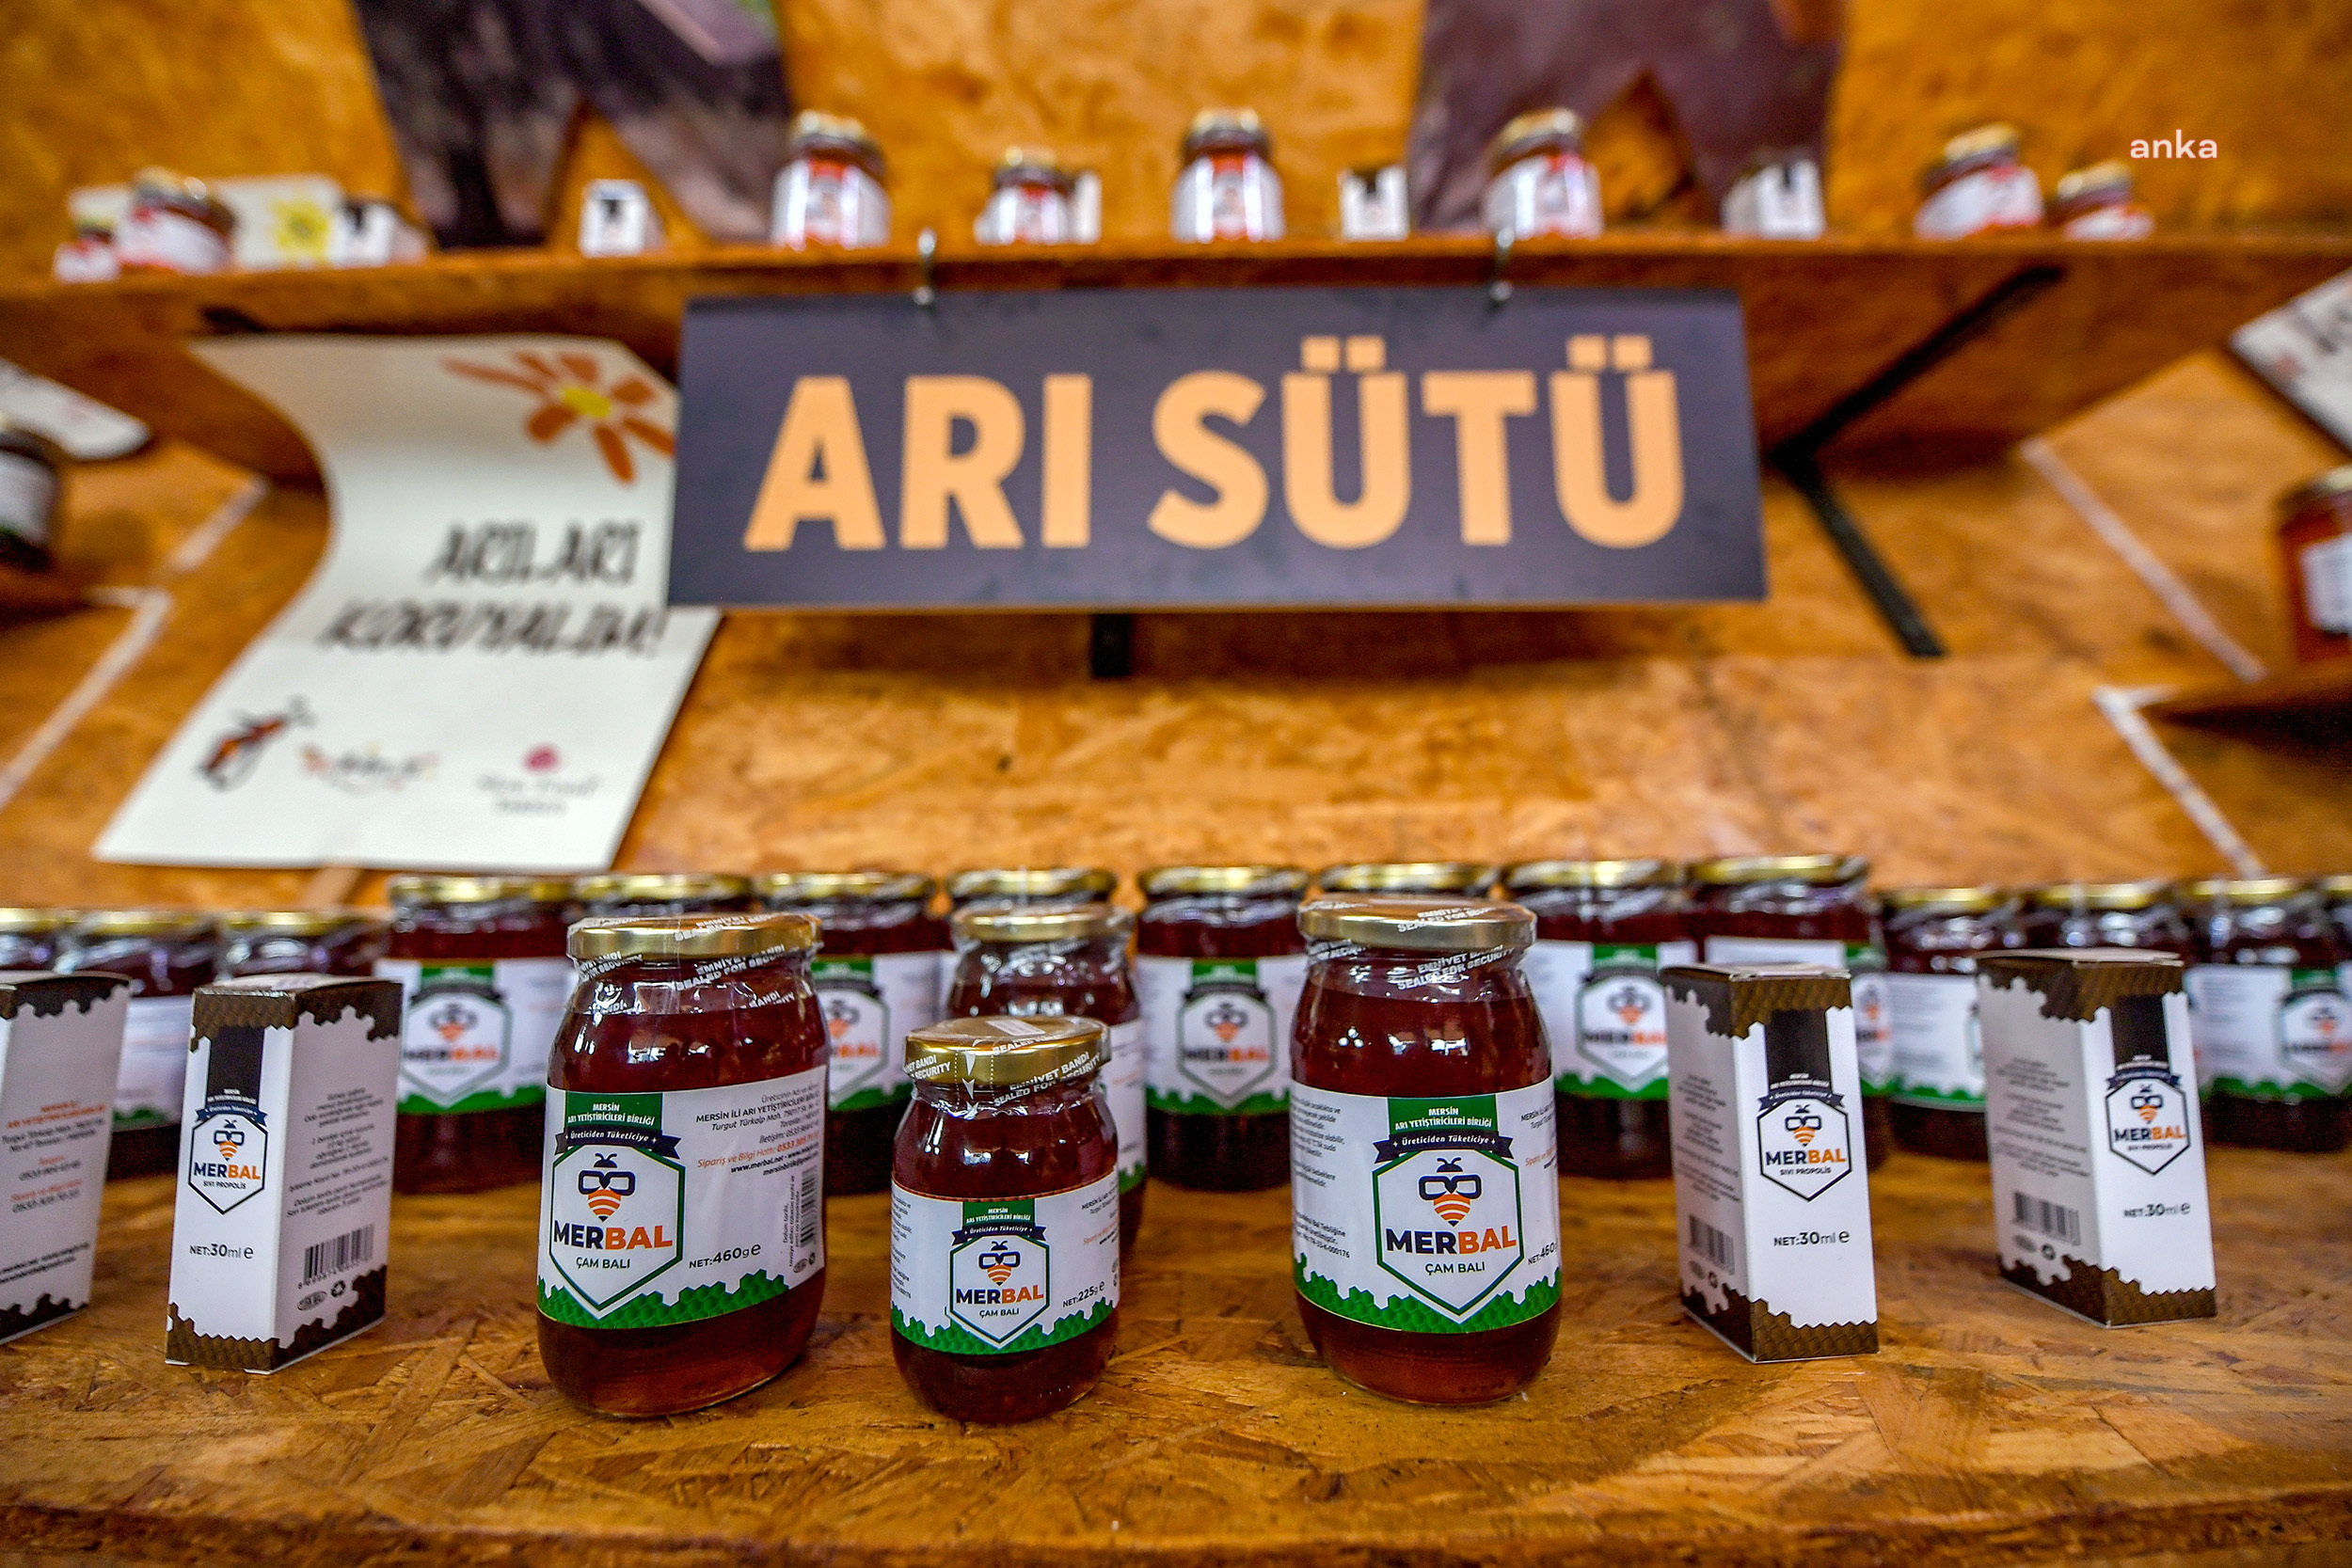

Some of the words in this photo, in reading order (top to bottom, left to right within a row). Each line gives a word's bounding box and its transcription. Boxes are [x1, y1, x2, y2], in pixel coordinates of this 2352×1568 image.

[743, 373, 1092, 551] ARI
[1147, 335, 1686, 551] SÜTÜ
[1061, 1051, 1089, 1074] BANDI
[593, 1102, 620, 1112] MERSİN
[1428, 1106, 1458, 1116] MERSİN
[567, 1116, 577, 1124] ARI
[627, 1115, 655, 1126] BİRLİĞİ
[696, 1112, 729, 1122] MERSİN
[742, 1107, 755, 1117] ARI
[1395, 1121, 1407, 1130] ARI
[1409, 1116, 1465, 1128] YETİŞTİRİCİLERİ
[1467, 1117, 1492, 1128] BİRLİĞİ
[570, 1131, 604, 1139] Üreticiden
[607, 1131, 649, 1142] Tüketiciye
[1402, 1135, 1445, 1146] Üreticiden
[1448, 1135, 1488, 1144] Tüketiciye
[2114, 1125, 2185, 1142] MERBAL
[1766, 1148, 1846, 1165] MERBAL
[194, 1162, 261, 1180] MERBAL
[553, 1220, 673, 1250] MERBAL
[1386, 1226, 1517, 1254] MERBAL
[576, 1257, 599, 1269] ÇAM
[602, 1259, 630, 1269] BALI
[1425, 1263, 1454, 1275] ÇAM
[1458, 1261, 1485, 1274] BALI
[956, 1285, 1043, 1305] MERBAL
[979, 1309, 998, 1319] ÇAM
[1000, 1307, 1019, 1316] BALI
